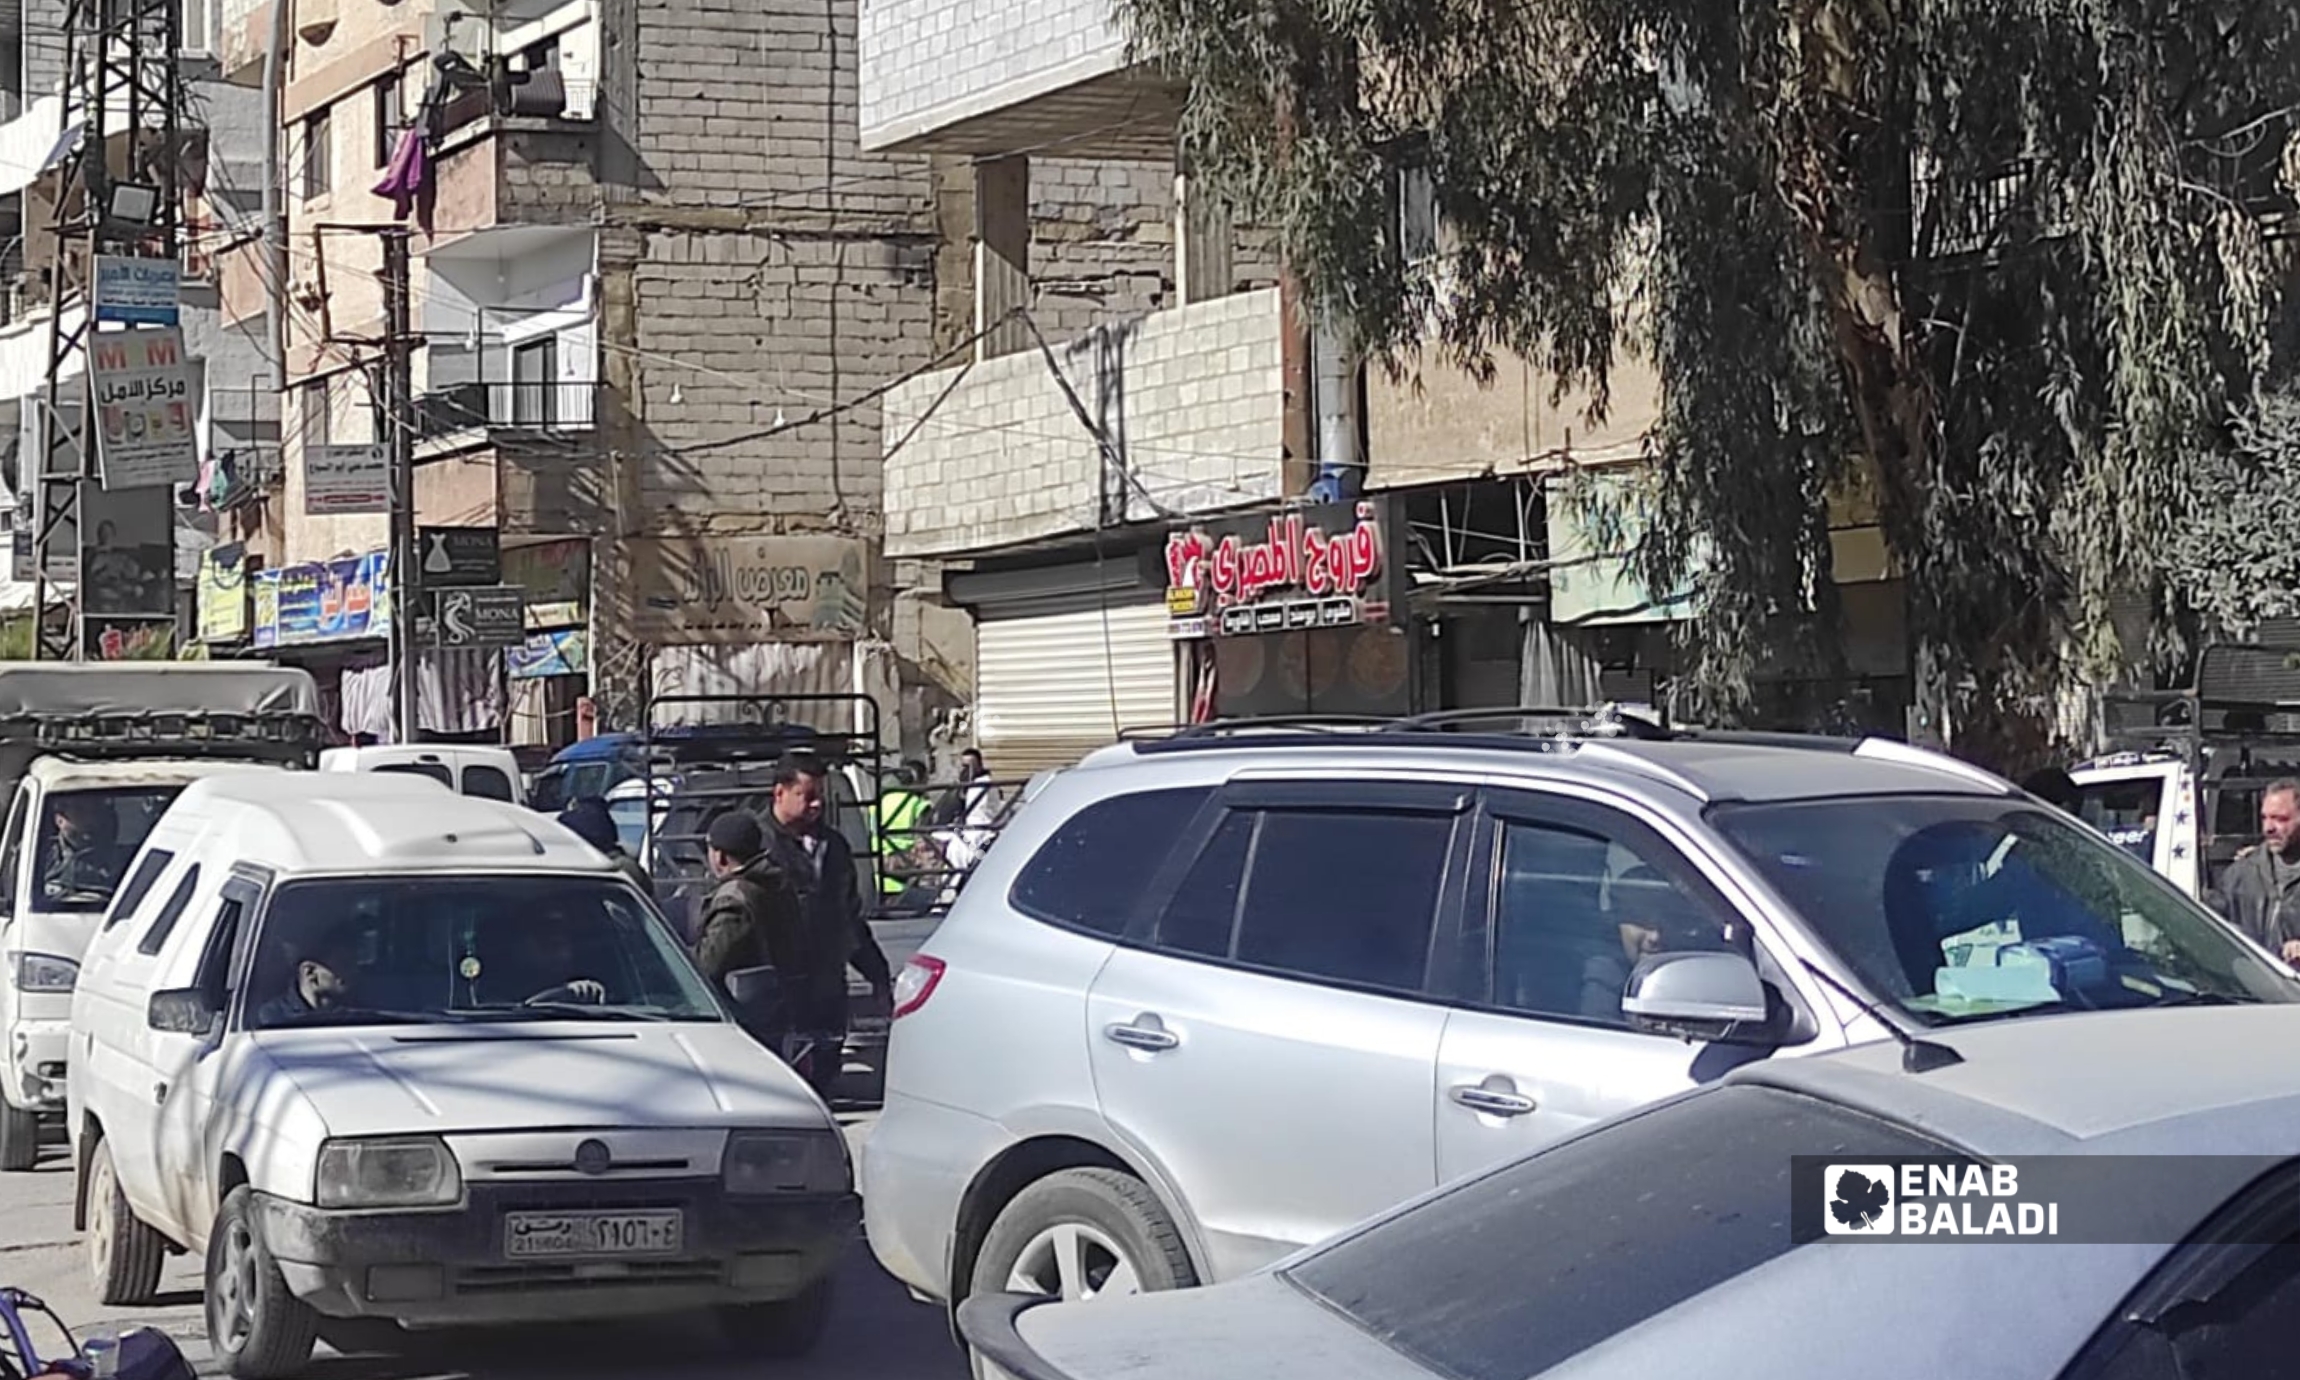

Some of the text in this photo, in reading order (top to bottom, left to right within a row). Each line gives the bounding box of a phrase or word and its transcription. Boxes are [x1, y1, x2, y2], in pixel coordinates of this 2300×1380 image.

[146, 376, 185, 400] مركز
[1211, 502, 1376, 606] فروج المصري
[735, 547, 810, 607] معرض
[475, 608, 519, 620] MONA
[597, 1219, 675, 1248] ٢١٥٦٠٤
